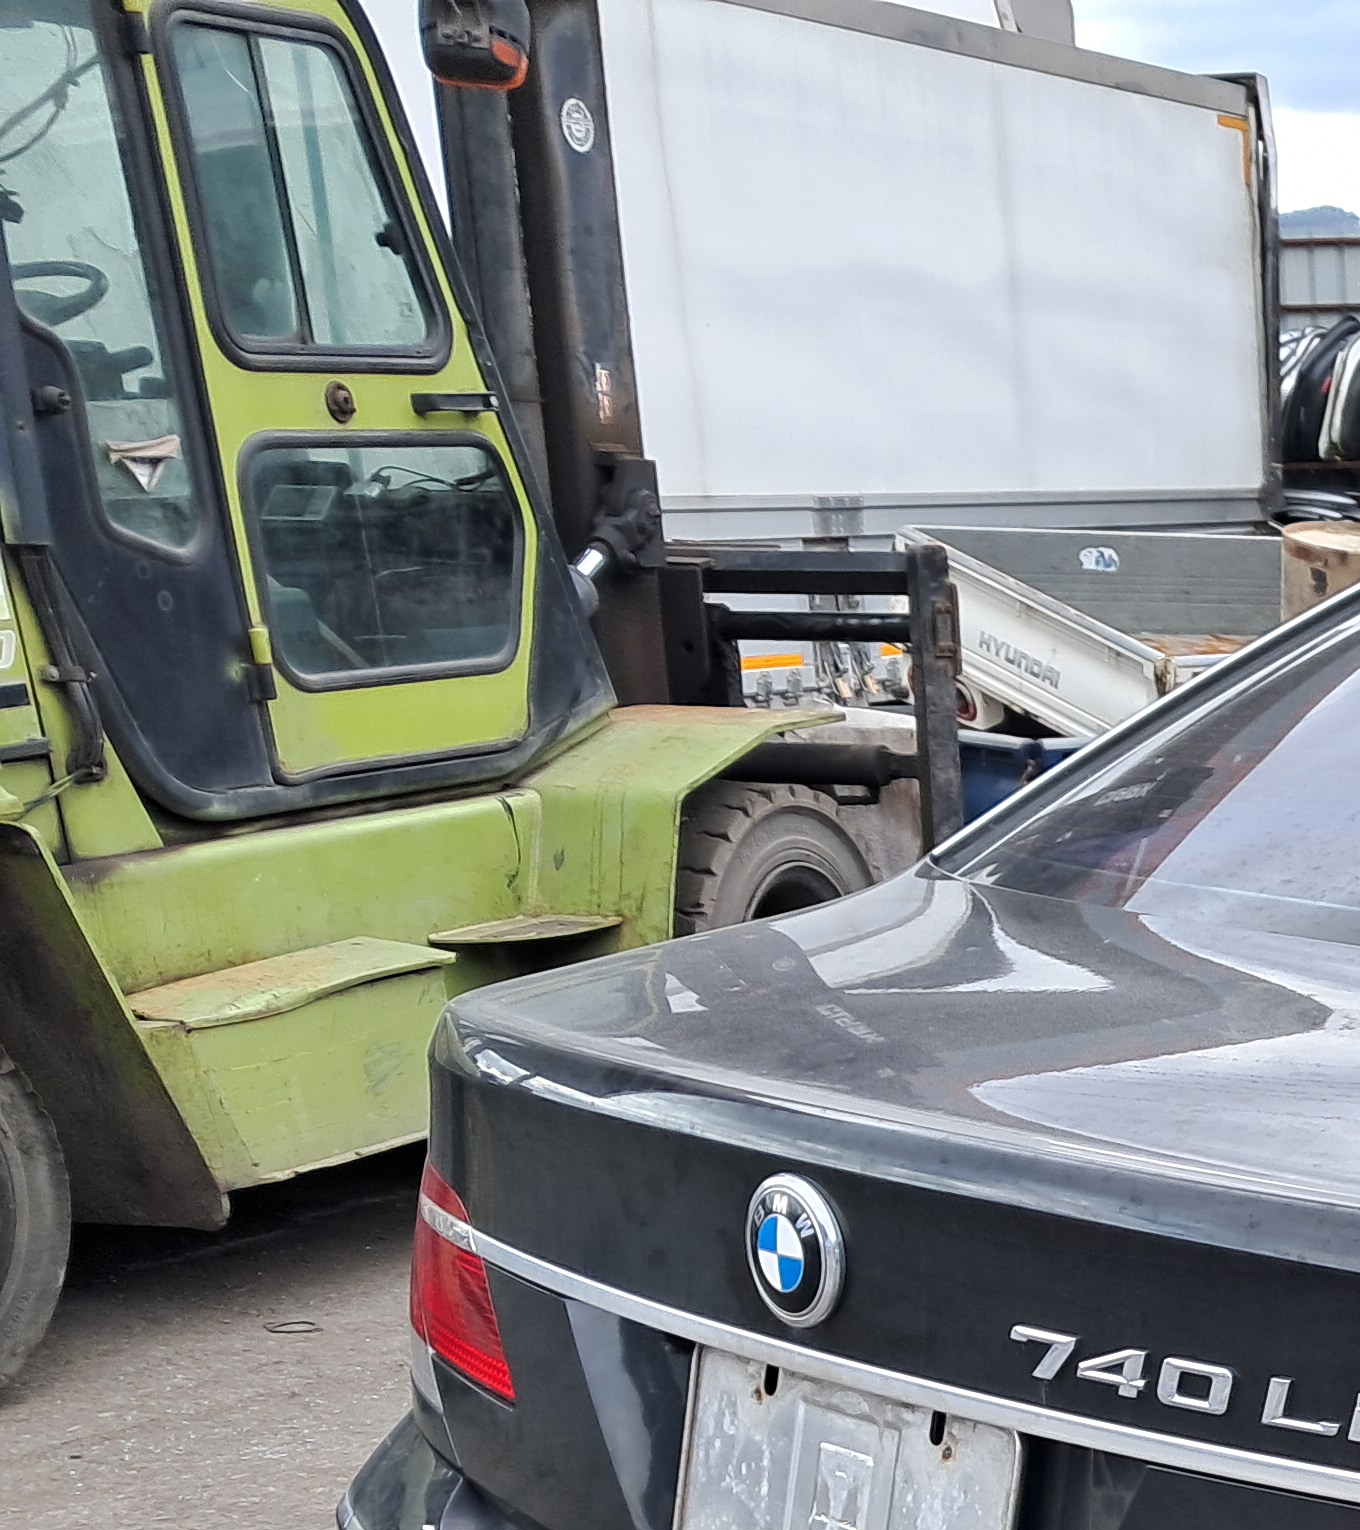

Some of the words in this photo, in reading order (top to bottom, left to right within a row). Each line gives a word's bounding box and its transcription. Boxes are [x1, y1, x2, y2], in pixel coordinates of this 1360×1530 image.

[979, 630, 1061, 690] HYUNDAI
[753, 1193, 815, 1239] BMW
[1010, 1323, 1234, 1416] 740
